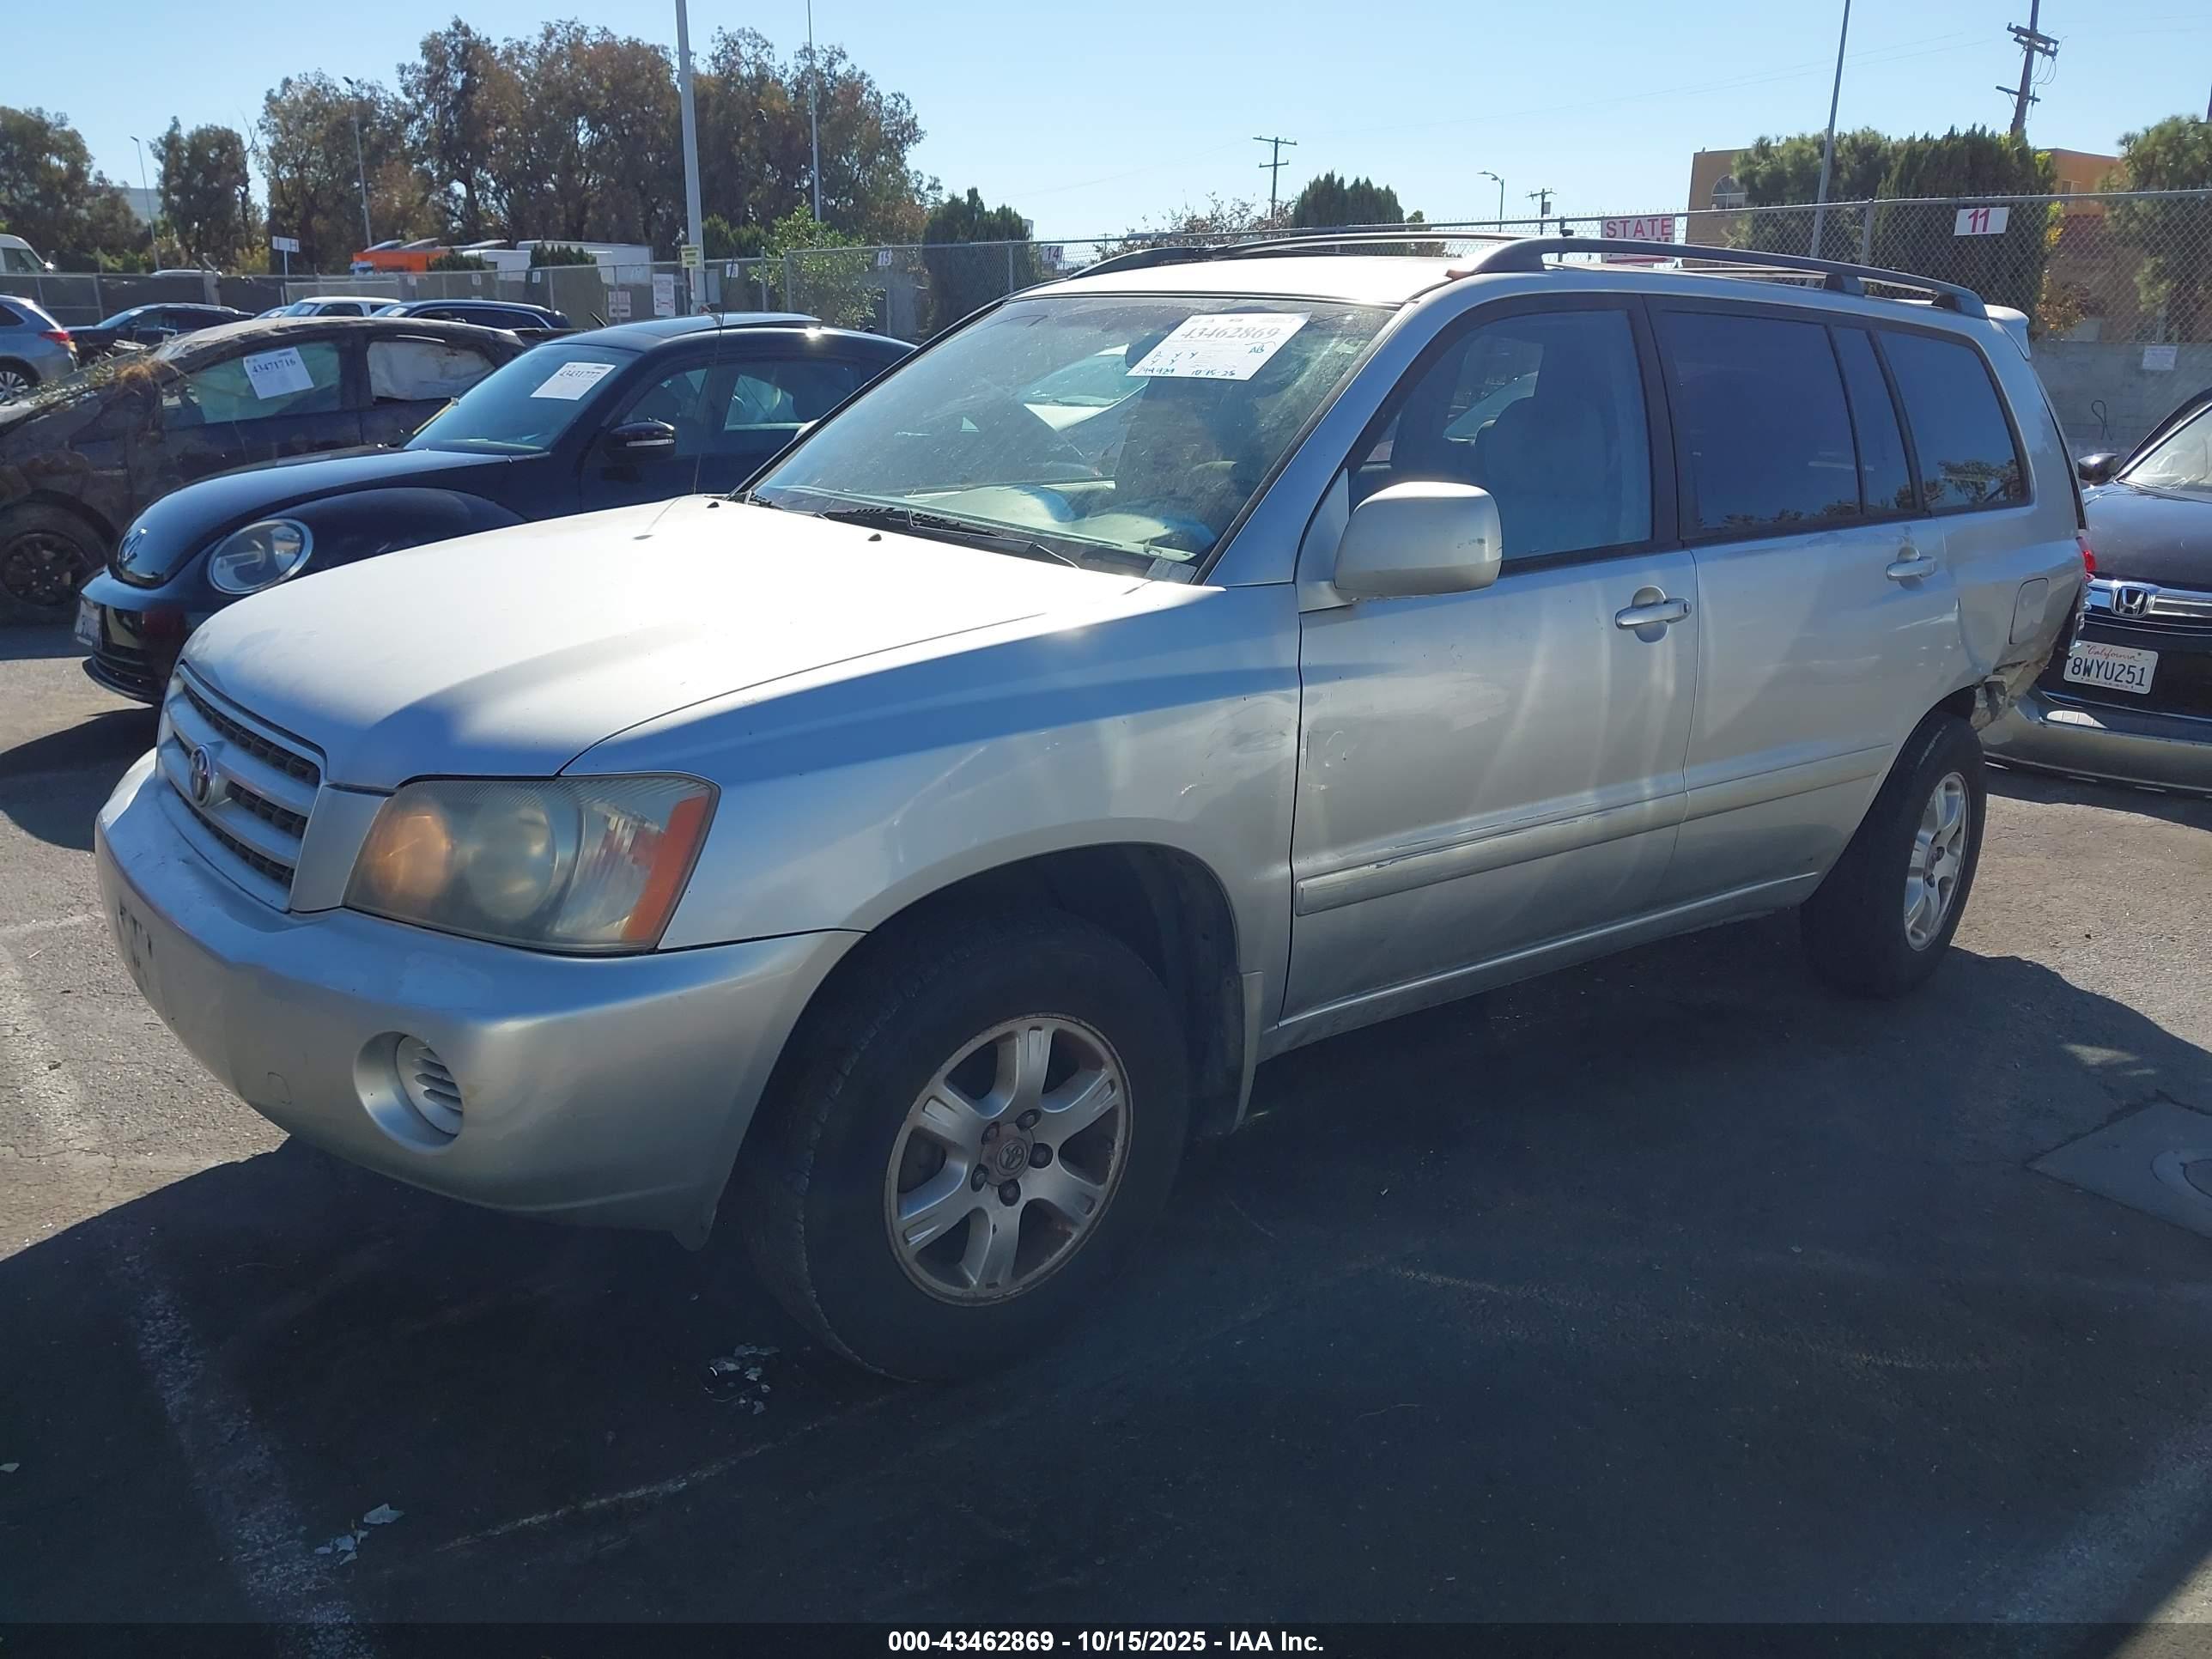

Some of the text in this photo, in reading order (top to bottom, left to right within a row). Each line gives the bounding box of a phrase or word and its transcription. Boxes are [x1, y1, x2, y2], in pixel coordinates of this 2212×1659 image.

[1606, 218, 1673, 238] STATE
[1968, 209, 1990, 233] 11
[1048, 246, 1060, 260] 14
[1182, 327, 1280, 339] 43462869
[2087, 645, 2141, 661] California
[2071, 657, 2147, 687] 8WYU251
